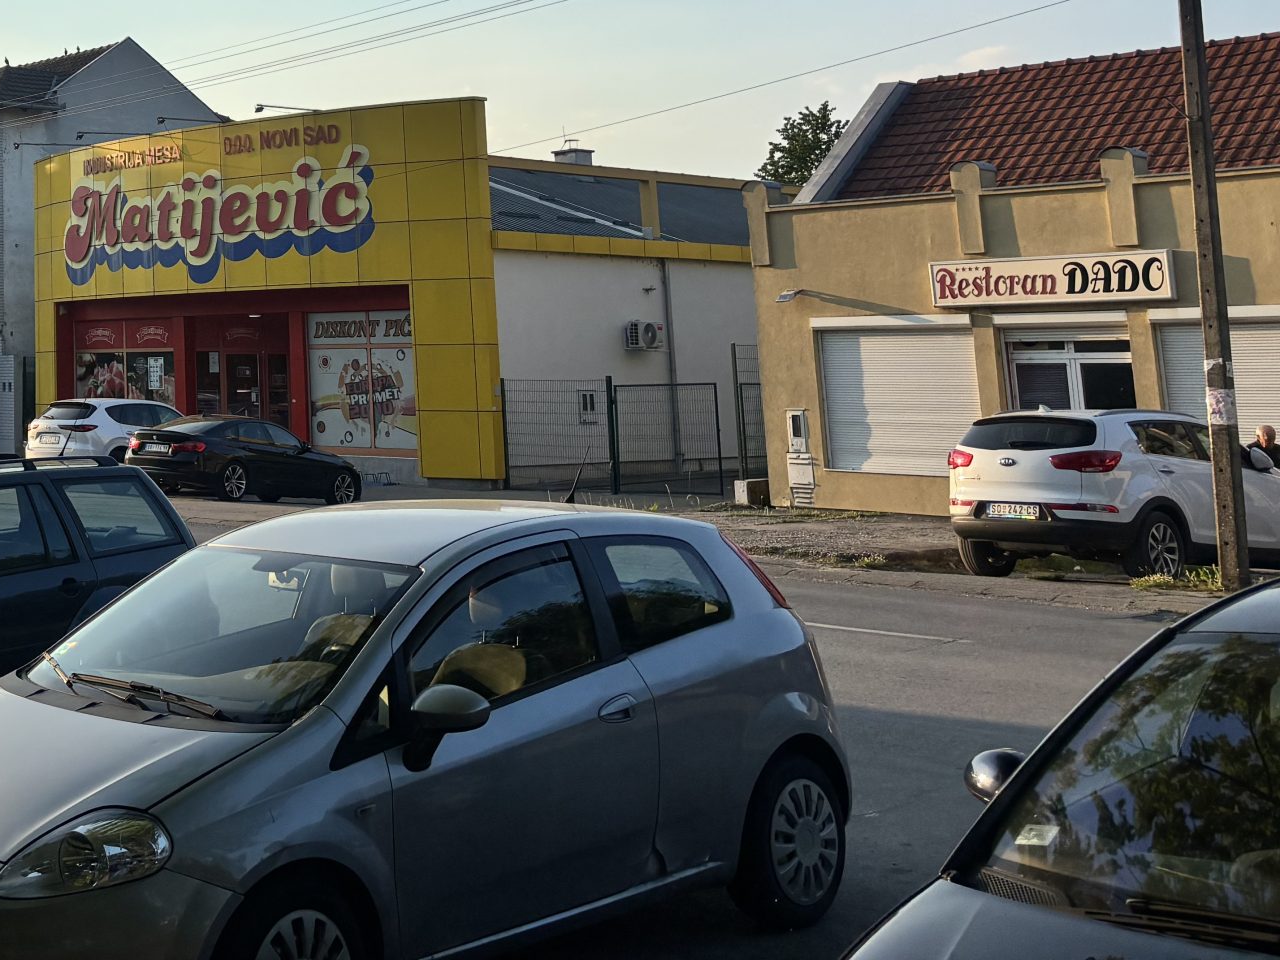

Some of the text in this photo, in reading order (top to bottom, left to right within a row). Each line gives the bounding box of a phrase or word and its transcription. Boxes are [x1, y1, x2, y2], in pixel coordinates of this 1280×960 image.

[223, 124, 341, 156] D.O.O. NOVI SAD
[83, 144, 182, 177] INDUSTRIJA MESA
[64, 151, 362, 263] Matijević
[935, 256, 1165, 299] Restoran DADO
[313, 320, 380, 338] DISKONT
